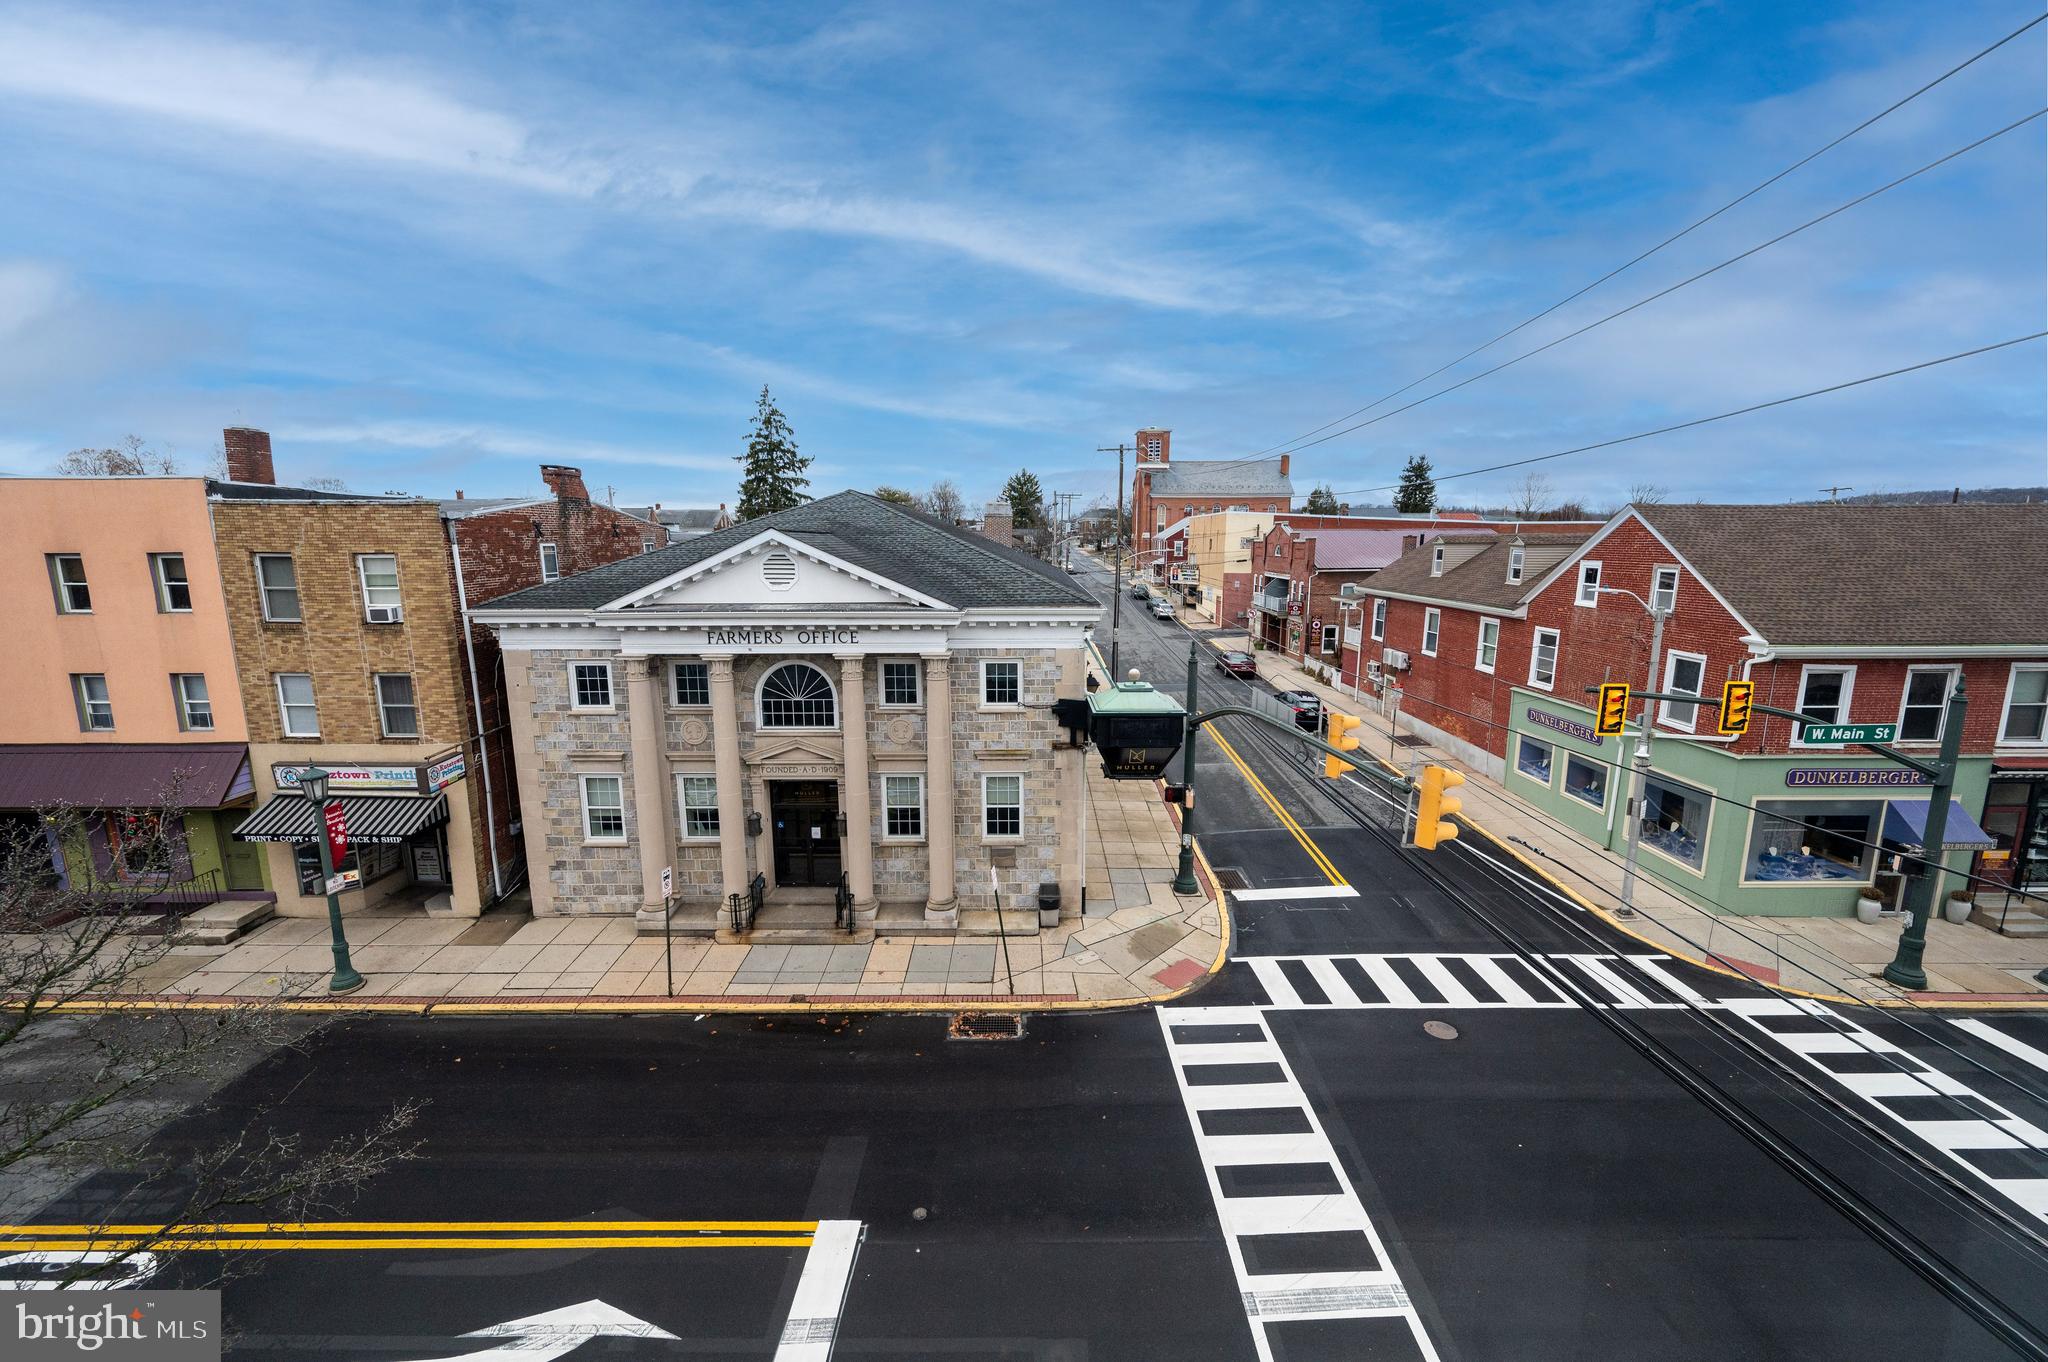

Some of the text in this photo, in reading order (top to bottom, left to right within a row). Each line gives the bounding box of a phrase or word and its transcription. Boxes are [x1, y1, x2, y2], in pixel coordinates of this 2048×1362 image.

[707, 631, 859, 644] FARMERS OFFICE
[1530, 710, 1598, 742] DUNKELBERGER'S
[1812, 727, 1890, 740] W. Main St
[374, 771, 417, 780] Printi
[761, 766, 798, 774] FOUNDED
[1795, 771, 1921, 784] DUNKELBERGER
[347, 836, 370, 844] PACK
[372, 836, 380, 844] &
[380, 836, 403, 844] SHIP
[1941, 842, 1990, 850] KELBERGERS
